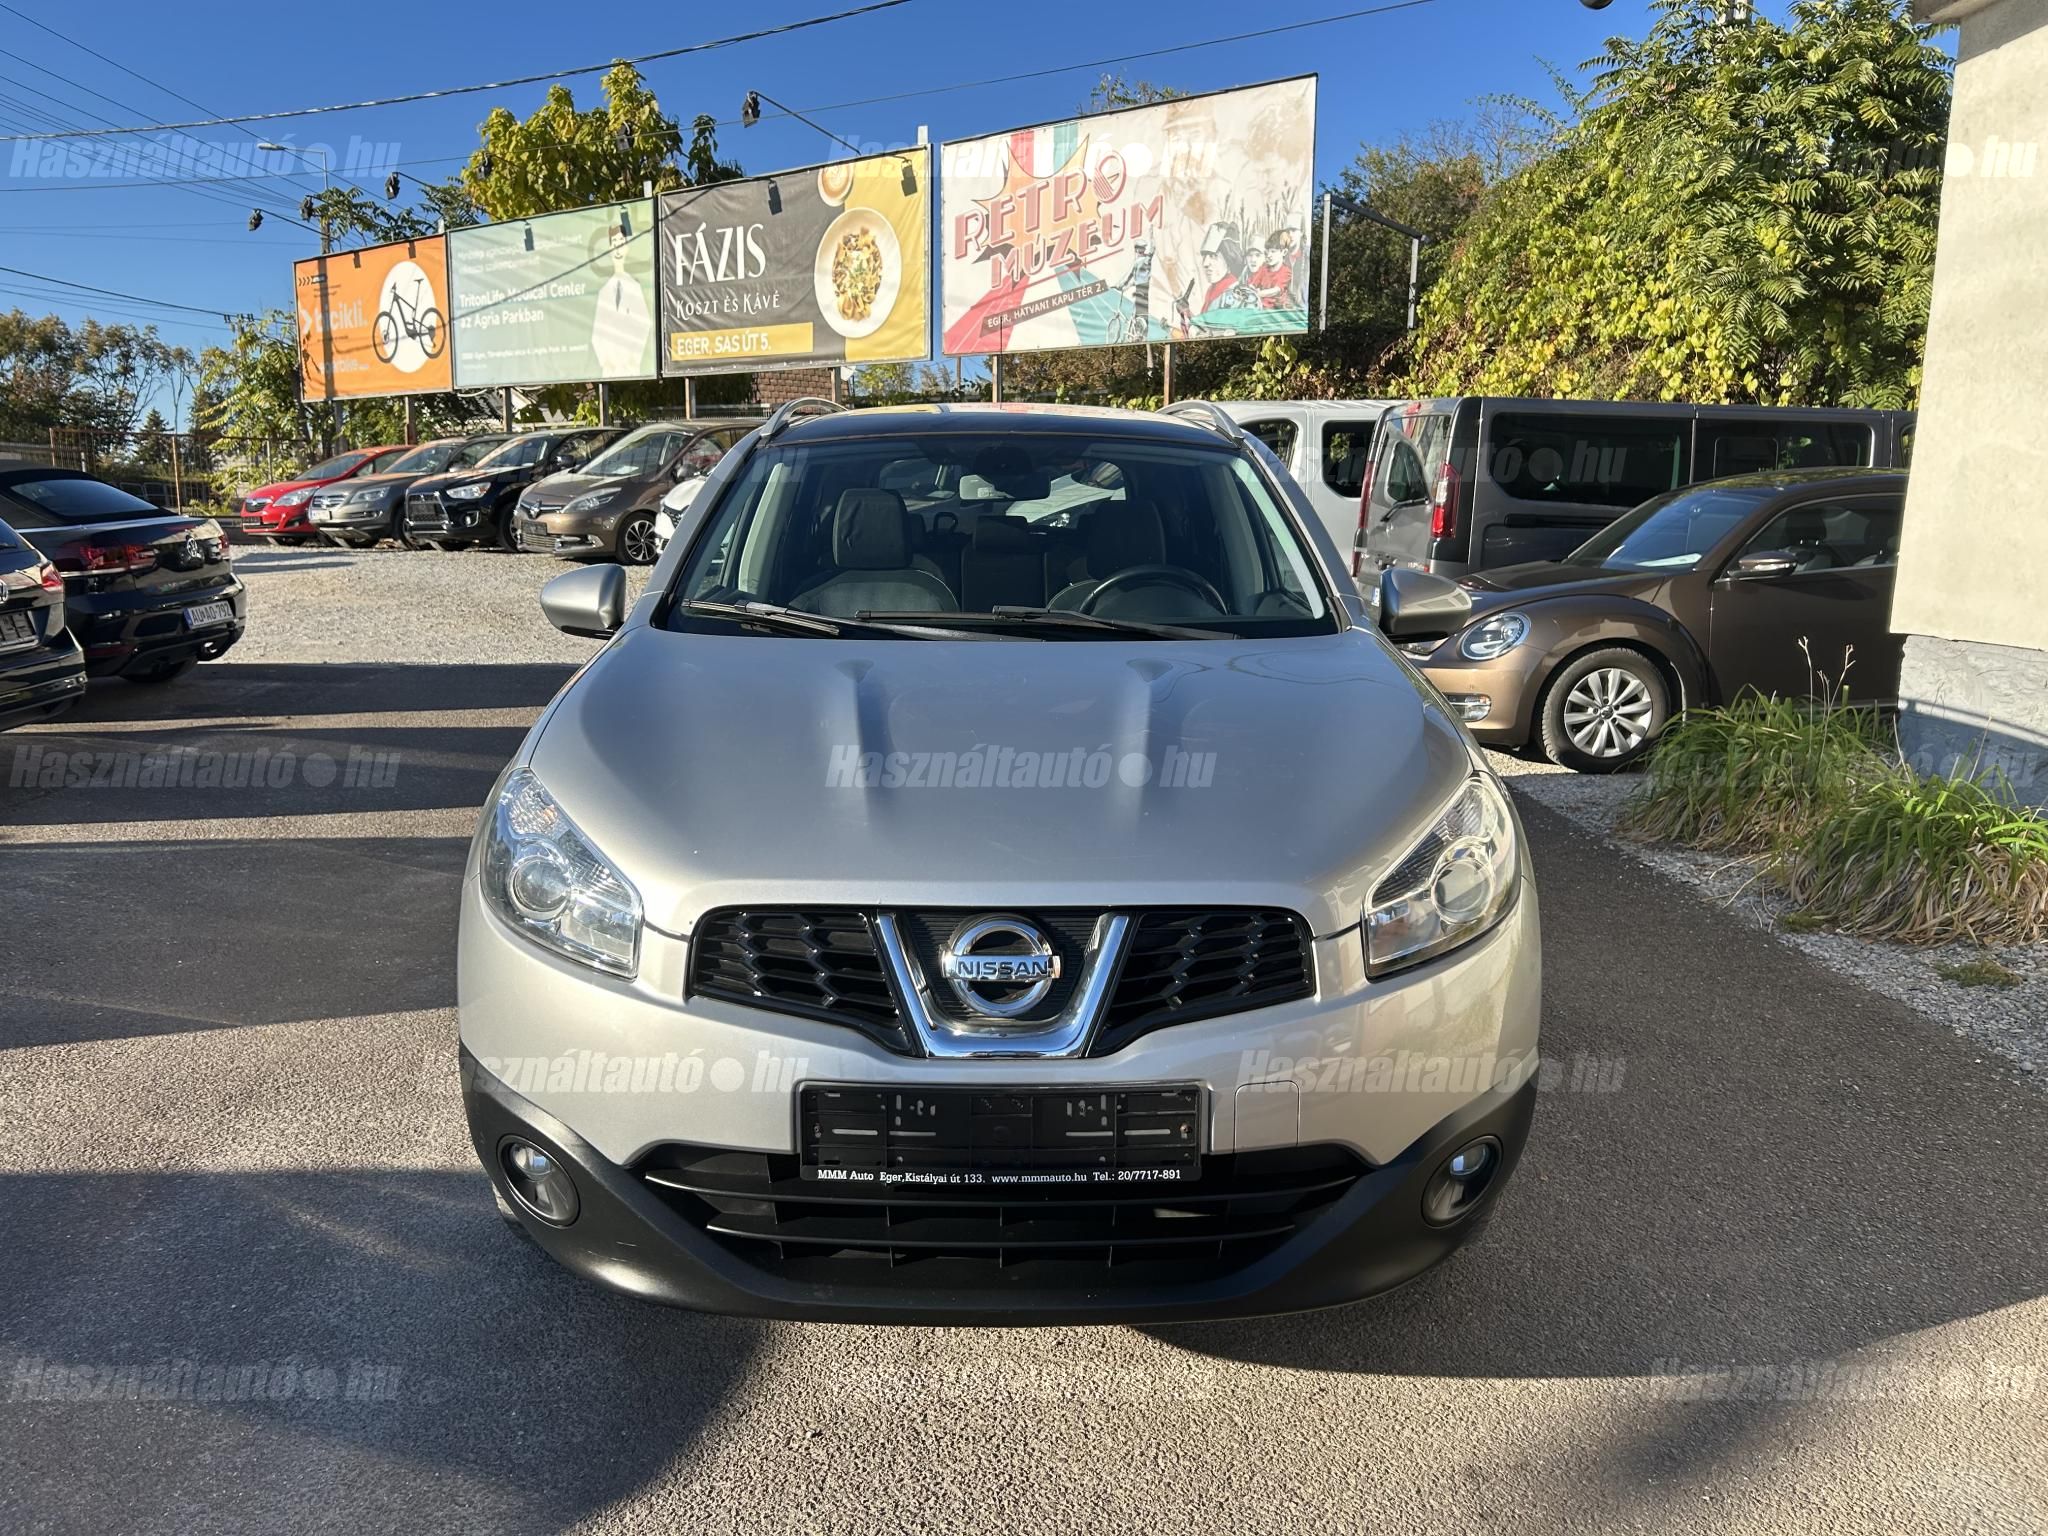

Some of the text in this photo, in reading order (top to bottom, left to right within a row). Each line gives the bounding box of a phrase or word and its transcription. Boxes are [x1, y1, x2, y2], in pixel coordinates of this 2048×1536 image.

[954, 151, 1127, 260] RETRO
[675, 222, 766, 286] FÁZIS
[459, 289, 506, 308] TritonLife
[550, 281, 586, 297] Center
[1014, 301, 1050, 319] HATVANI
[1051, 292, 1074, 307] KAPU
[474, 312, 500, 330] Agria
[502, 307, 544, 325] Parkban
[714, 335, 740, 353] SAS
[742, 330, 759, 352] ÚT
[957, 961, 1048, 976] NISSAN
[817, 1169, 847, 1180] MMM
[849, 1170, 874, 1181] Auto
[950, 1173, 961, 1183] út
[964, 1174, 986, 1183] 133.
[991, 1172, 1087, 1183] www.mmmauto.hu
[1093, 1171, 1115, 1181] Tel.:
[1117, 1169, 1181, 1181] 20/7717-891
